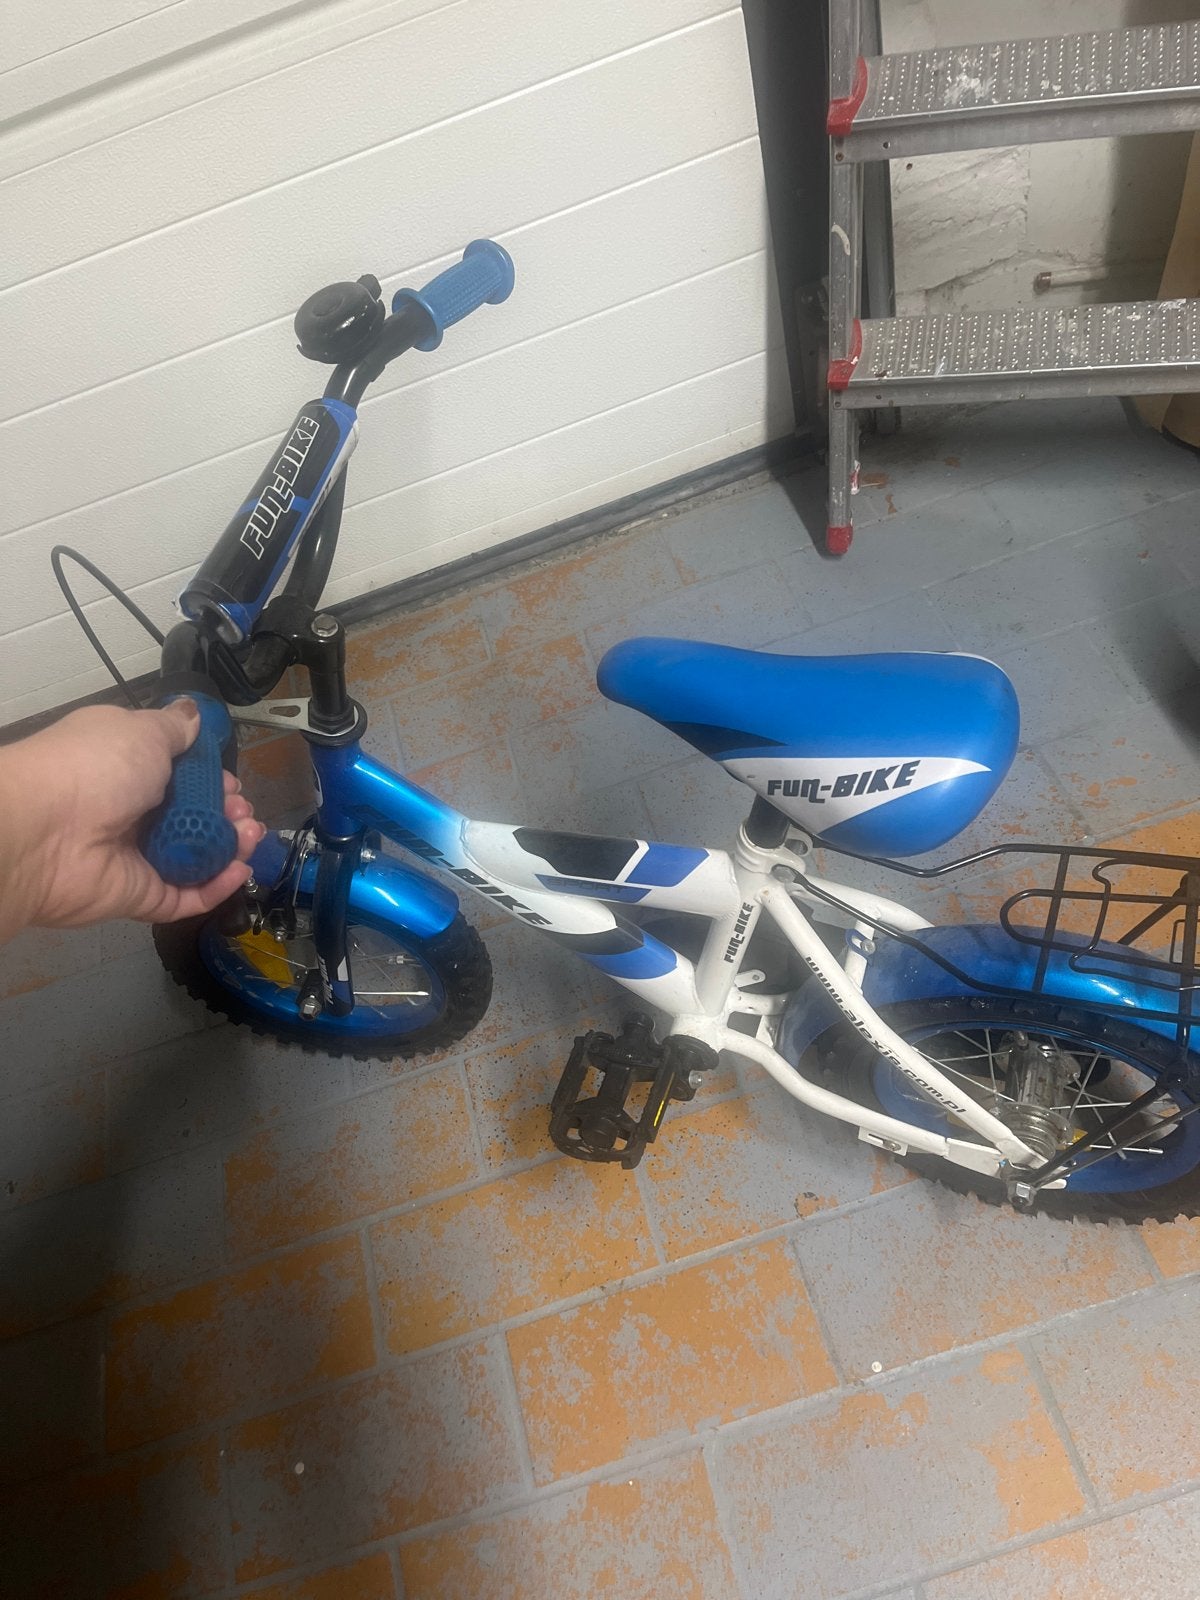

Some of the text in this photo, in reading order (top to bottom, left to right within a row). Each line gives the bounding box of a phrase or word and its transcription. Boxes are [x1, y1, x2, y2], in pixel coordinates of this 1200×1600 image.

[240, 416, 320, 560] FUN-BIKE
[767, 759, 921, 804] FUN-BIKE
[723, 902, 754, 963] FUN-BIKE
